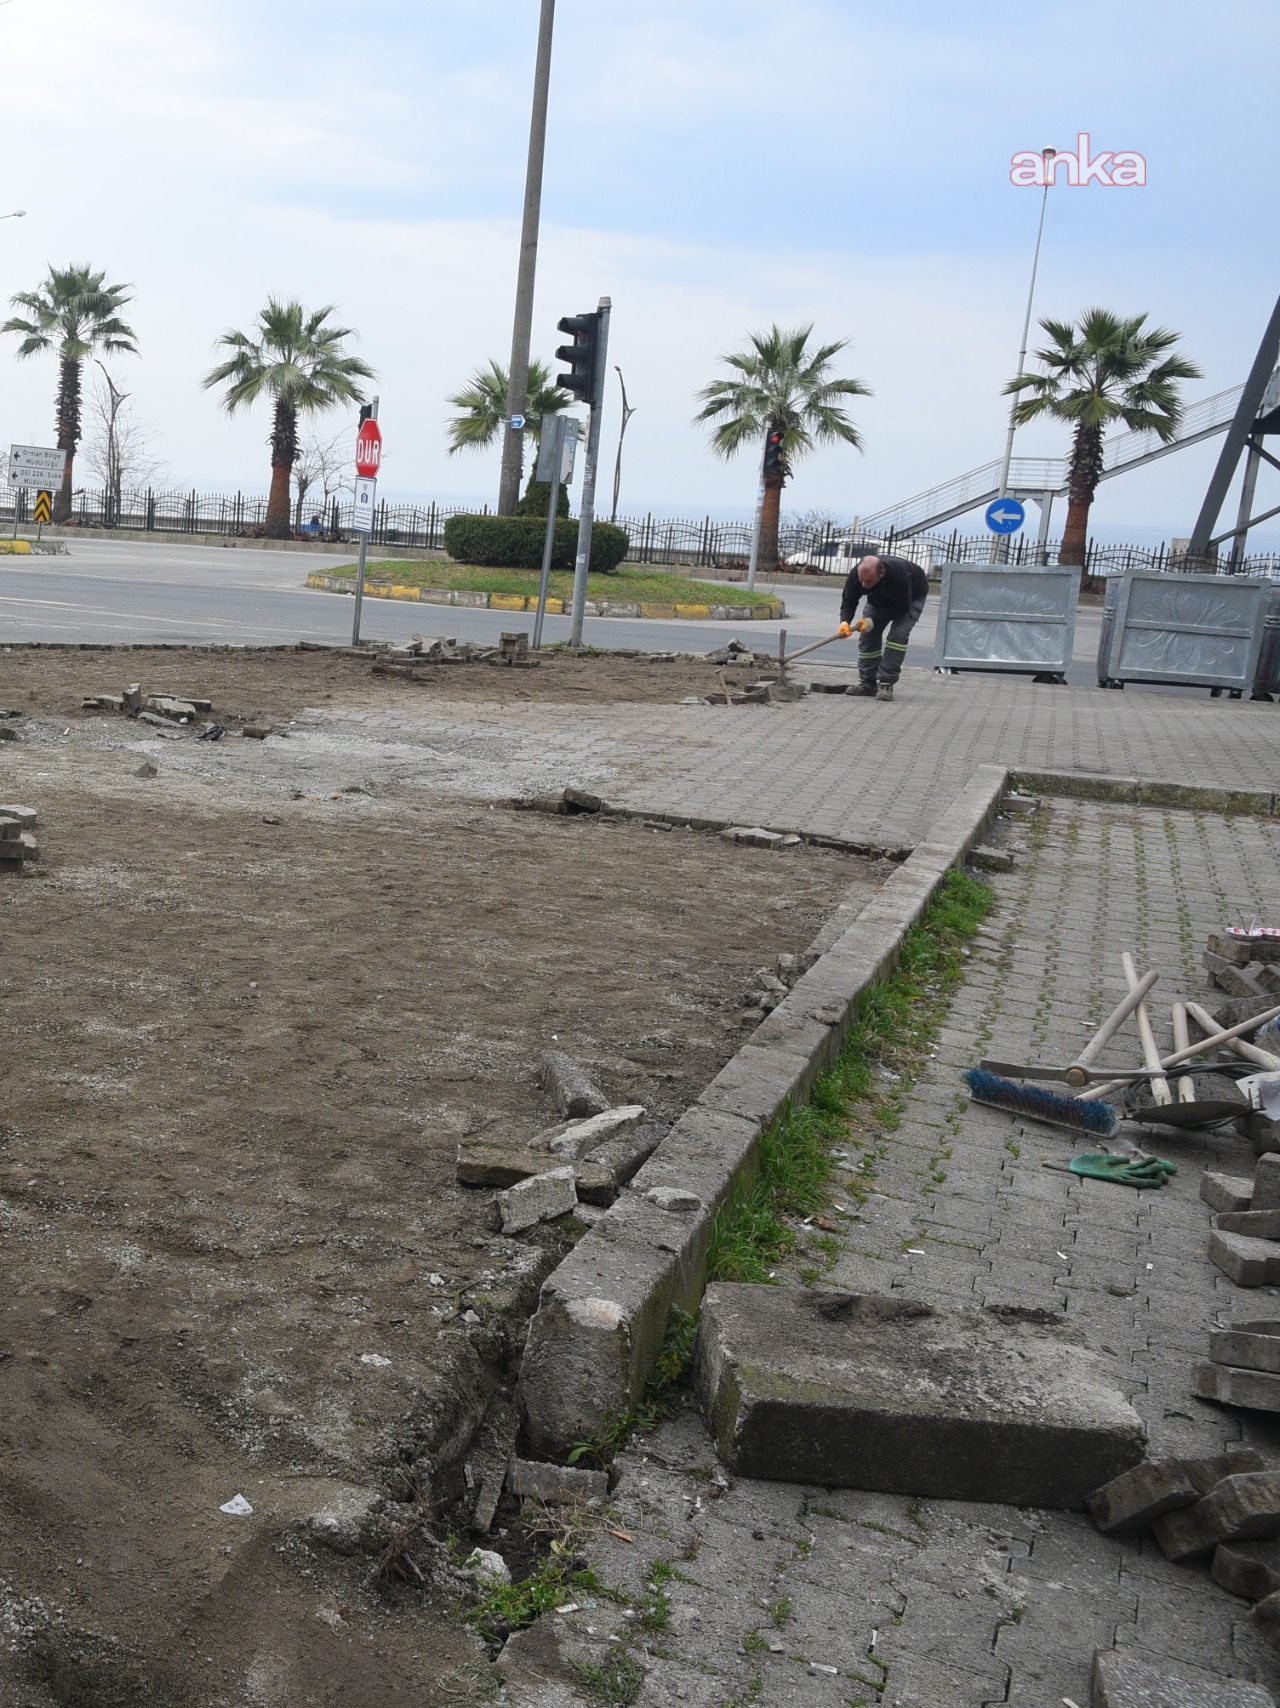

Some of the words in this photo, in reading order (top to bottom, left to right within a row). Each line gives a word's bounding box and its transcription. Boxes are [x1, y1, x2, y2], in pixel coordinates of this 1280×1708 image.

[22, 449, 43, 457] Orman
[44, 451, 61, 460] Bölge
[357, 439, 379, 464] DUR
[26, 458, 58, 468] Müdürlüğü
